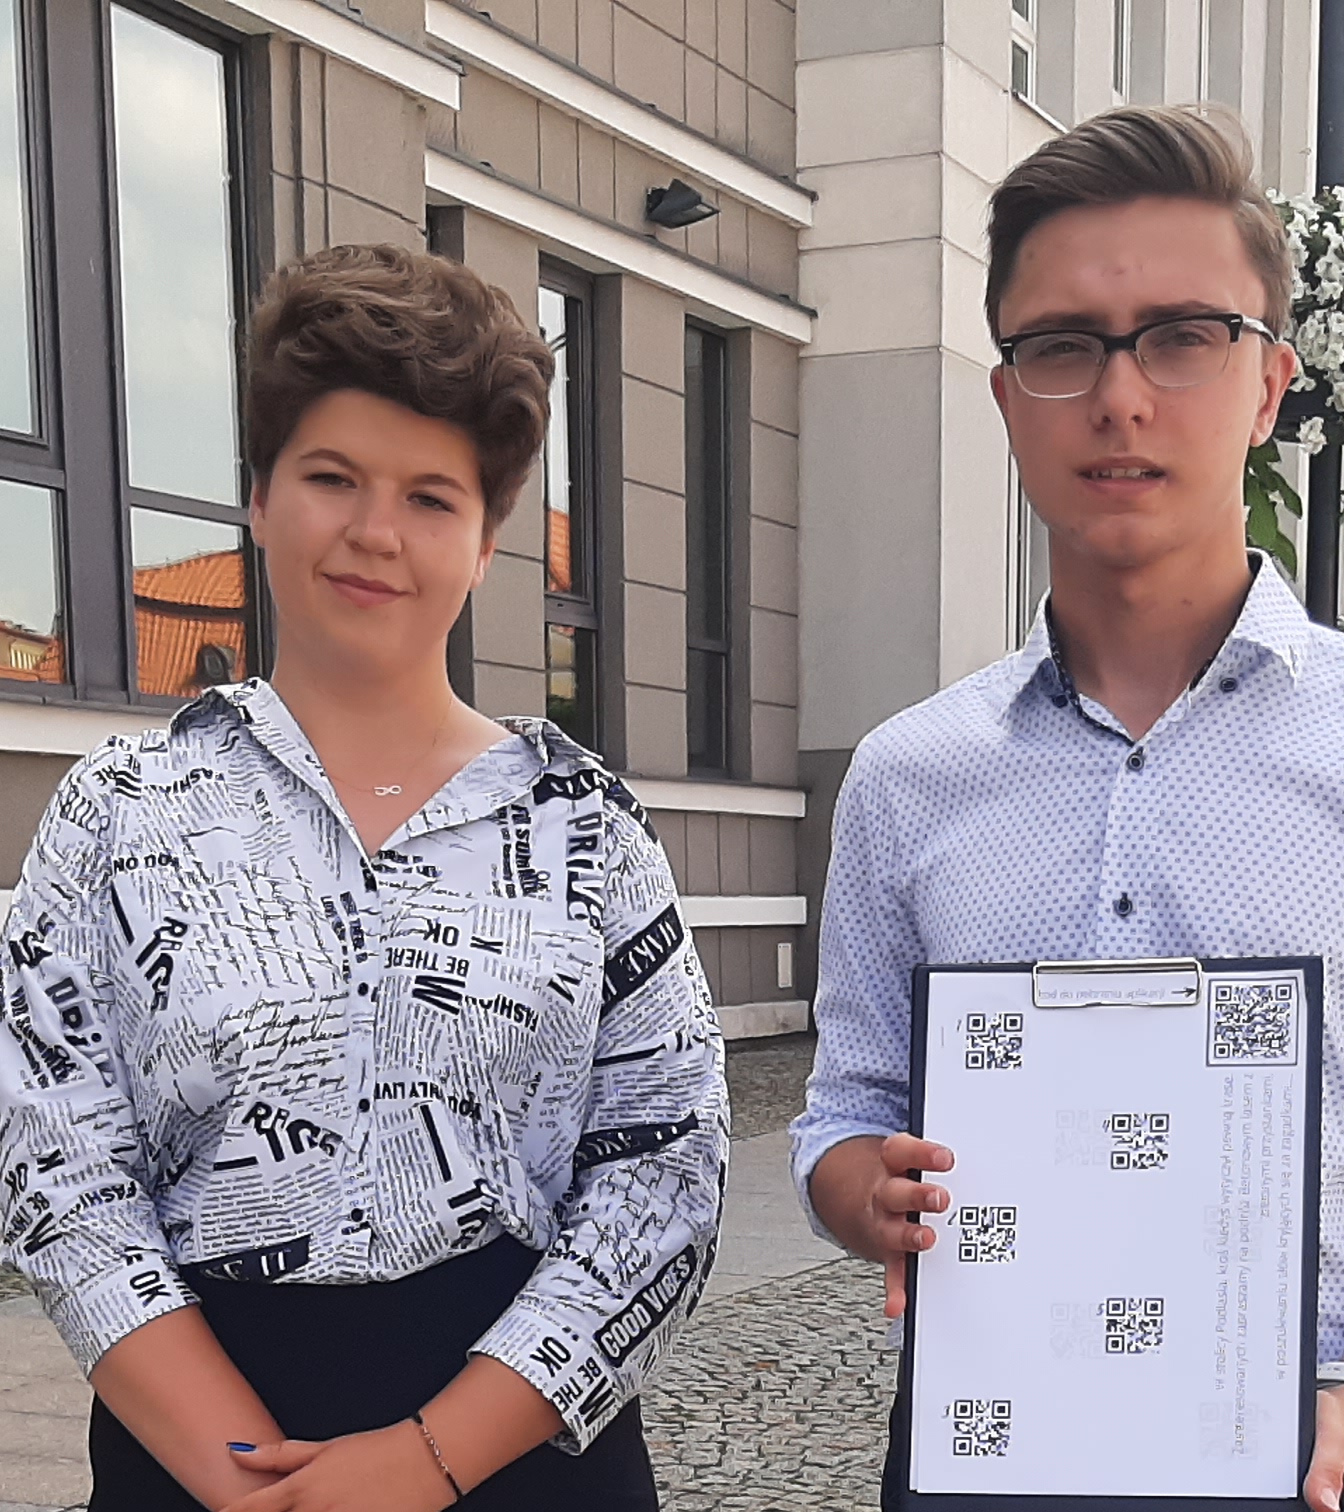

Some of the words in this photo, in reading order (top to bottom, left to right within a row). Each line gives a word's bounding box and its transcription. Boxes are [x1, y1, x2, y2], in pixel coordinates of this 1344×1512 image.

[423, 919, 459, 947] OK
[128, 1269, 172, 1308] OK
[599, 1296, 653, 1359] GOOD
[641, 1253, 692, 1313] VIBES
[530, 1335, 572, 1378] OK
[577, 1356, 603, 1386] BE
